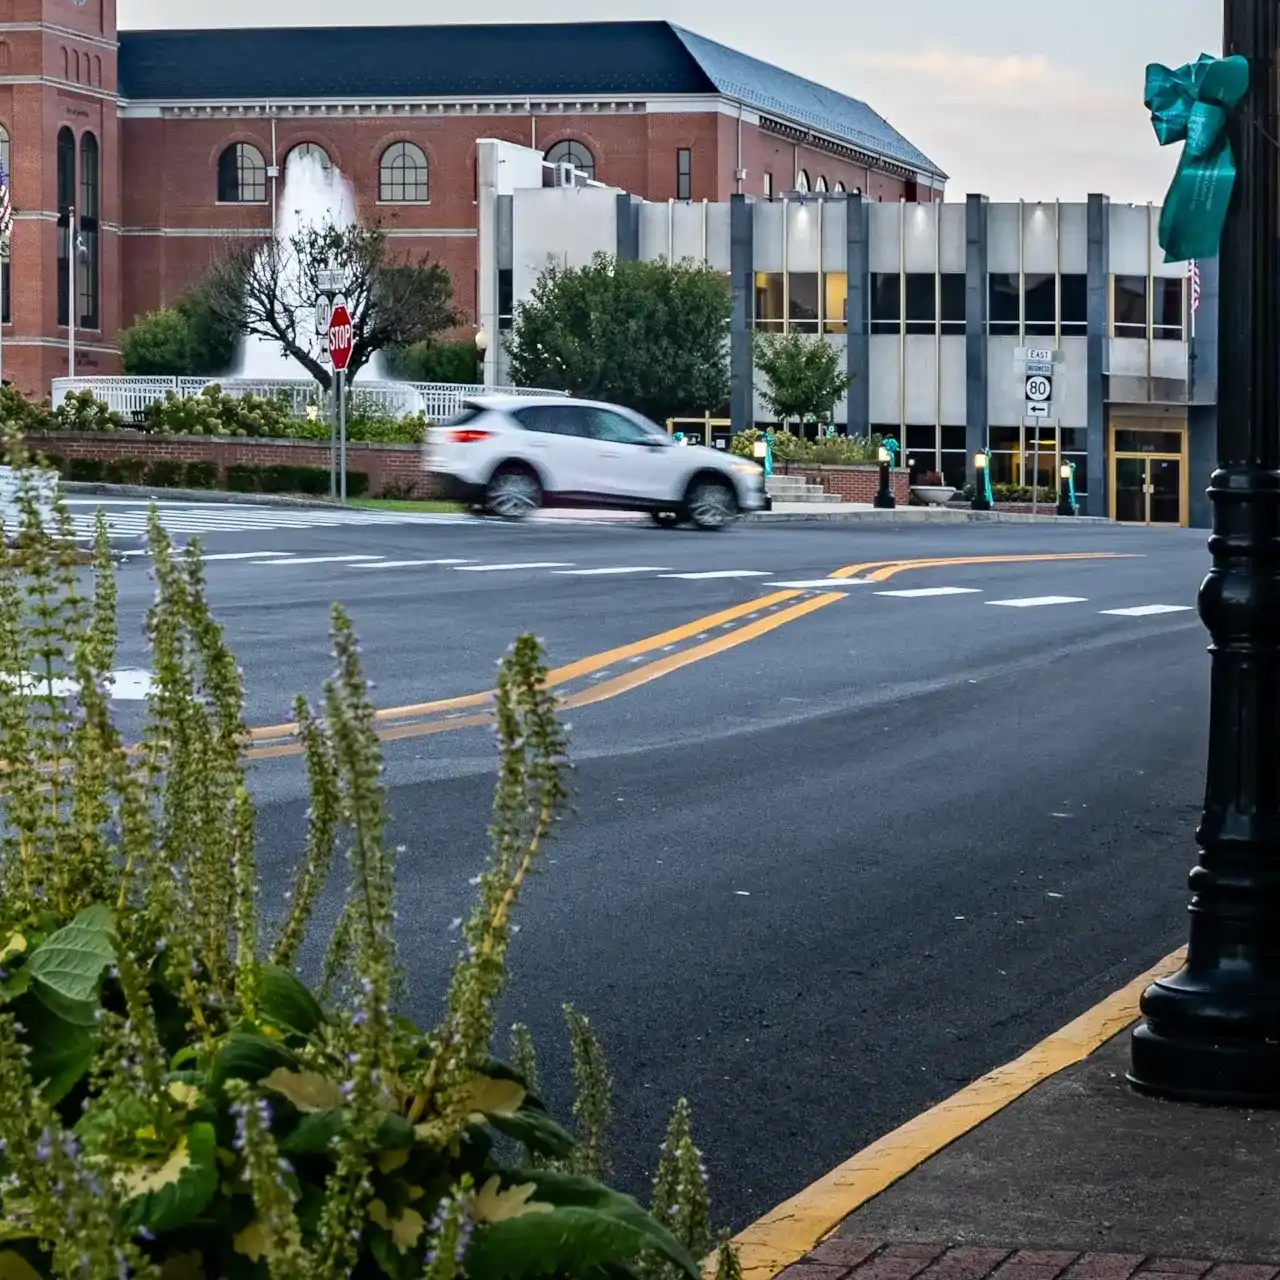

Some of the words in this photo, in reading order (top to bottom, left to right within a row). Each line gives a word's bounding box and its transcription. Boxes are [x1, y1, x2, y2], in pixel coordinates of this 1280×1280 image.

[330, 325, 351, 351] STOP
[1031, 350, 1048, 359] EAST
[1030, 381, 1046, 395] 80
